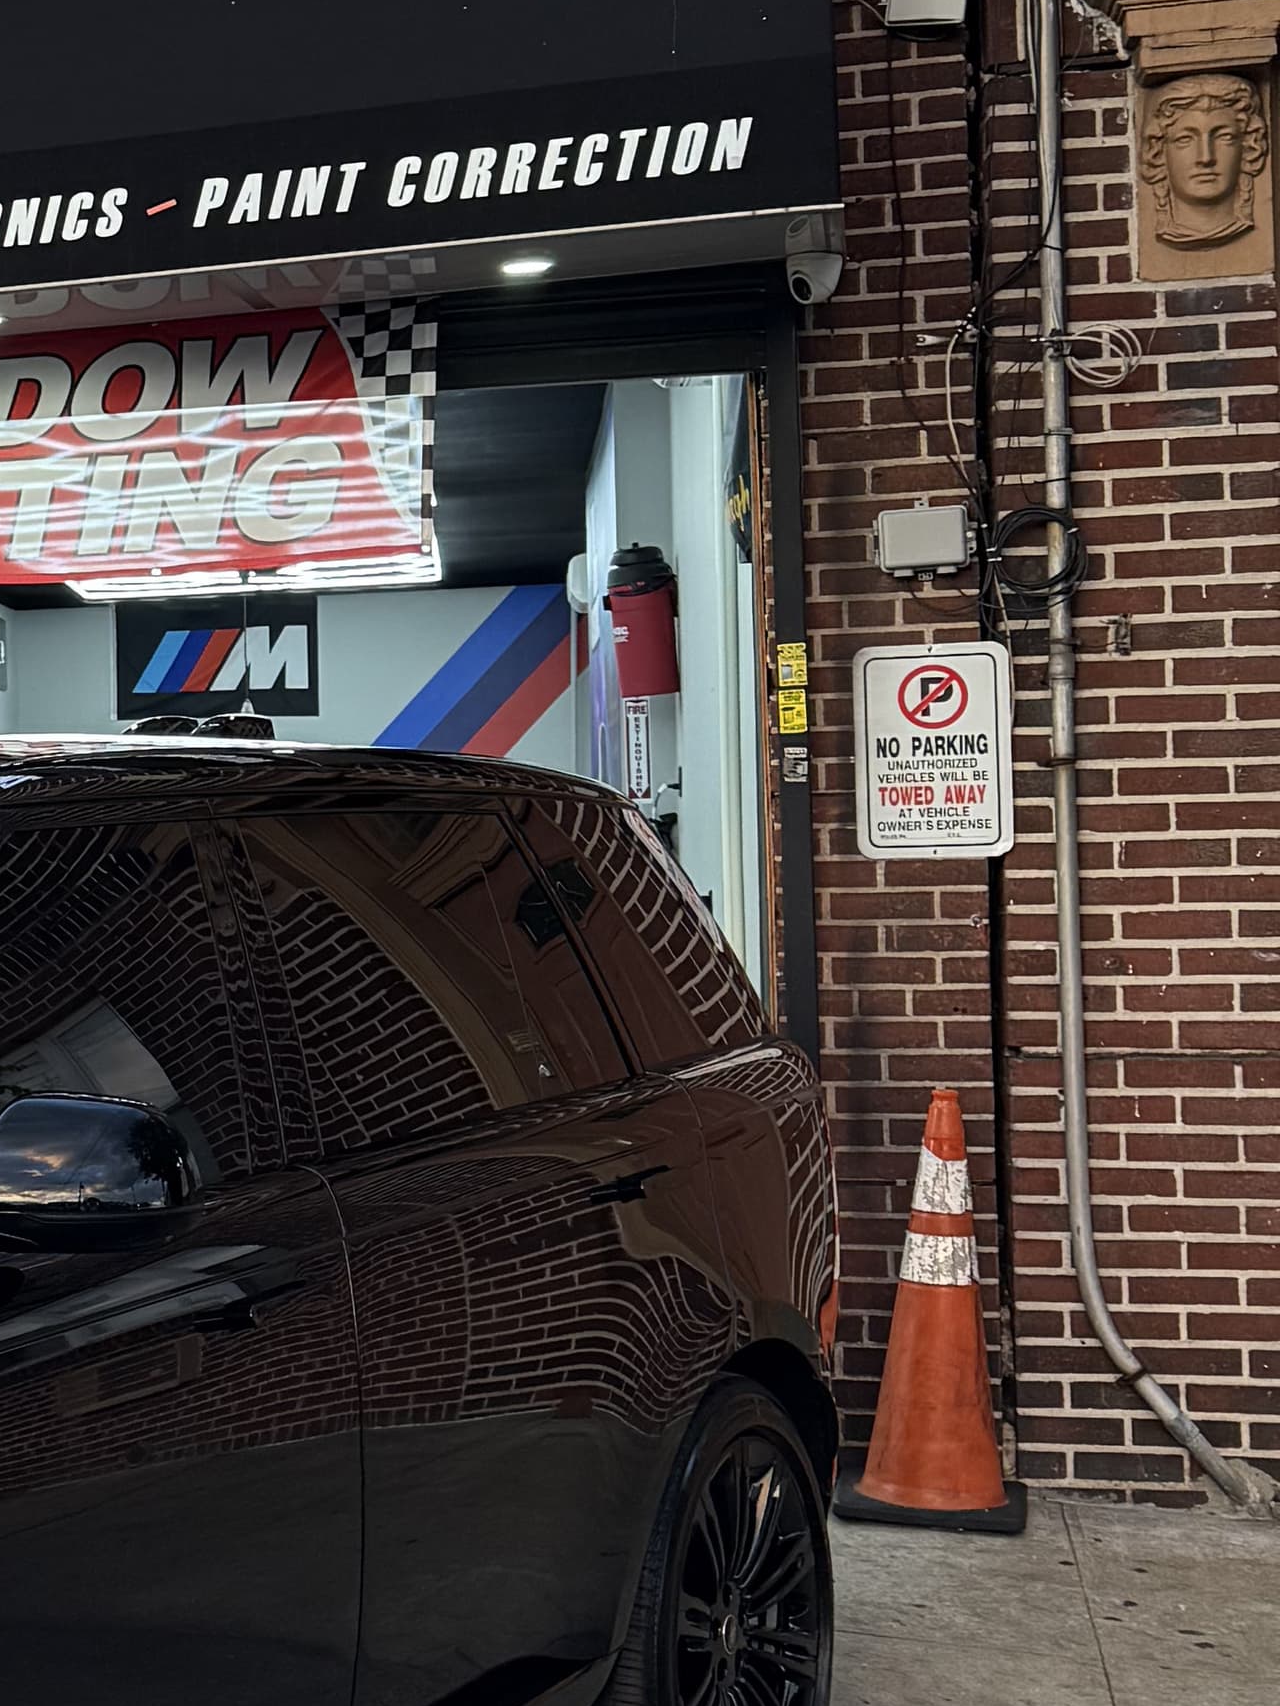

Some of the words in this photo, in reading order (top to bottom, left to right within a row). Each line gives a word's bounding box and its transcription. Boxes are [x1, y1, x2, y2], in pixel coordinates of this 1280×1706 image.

[191, 160, 367, 228] PAINT
[386, 116, 755, 209] CORRECTION
[627, 705, 647, 715] FIRE
[876, 737, 900, 758] NO
[911, 734, 988, 757] PARKING
[888, 758, 978, 771] UNAUTHORIZED
[878, 772, 935, 784] VEHICLES
[940, 771, 968, 782] WILL
[973, 770, 989, 781] BE
[878, 785, 934, 806] TOWED
[944, 784, 986, 805] AWAY
[899, 808, 913, 818] AT
[919, 806, 970, 818] VEHICLE
[877, 820, 934, 832] OWNER'S
[936, 818, 993, 830] EXPENSE
